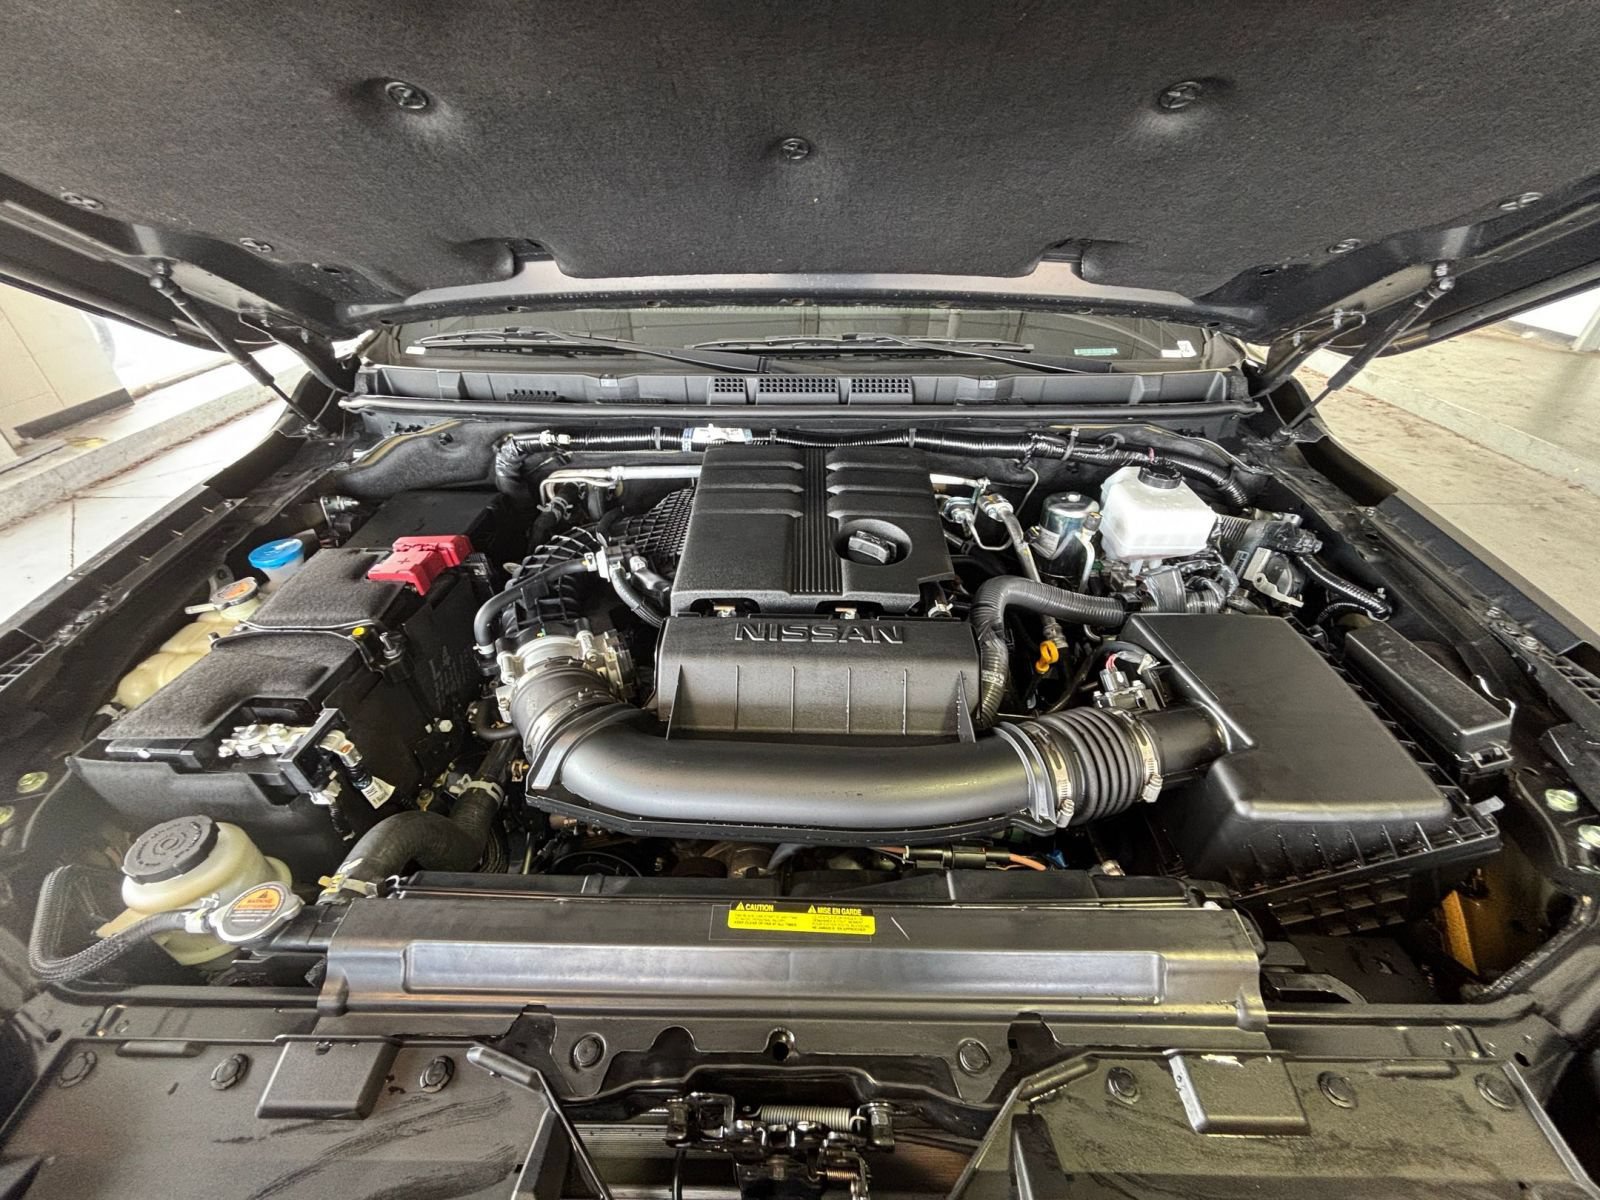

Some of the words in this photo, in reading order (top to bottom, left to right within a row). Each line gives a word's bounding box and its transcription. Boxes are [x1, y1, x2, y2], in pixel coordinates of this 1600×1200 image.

[735, 622, 904, 644] NISSAN
[744, 903, 774, 912] CAUTION
[816, 906, 832, 915] MISE
[833, 907, 841, 915] EN
[842, 908, 862, 917] GARDE
